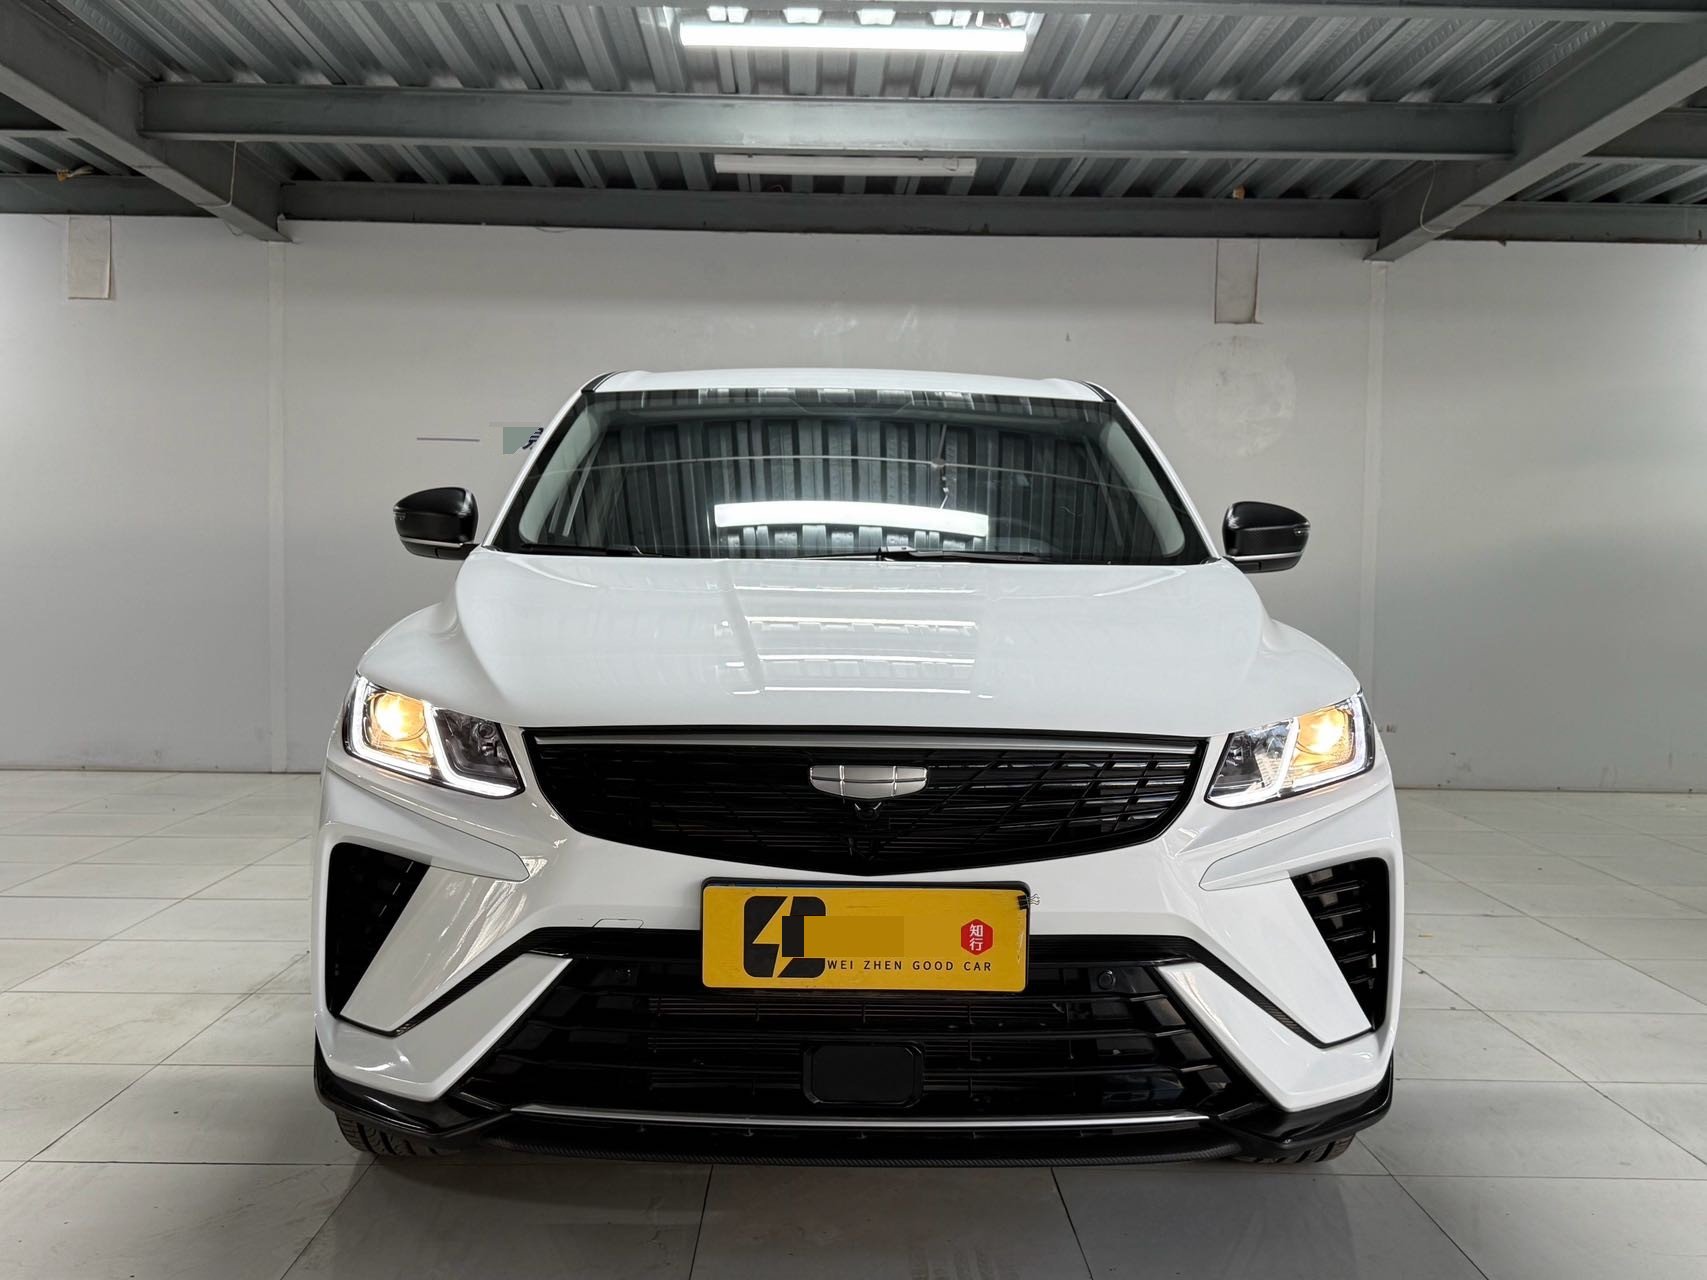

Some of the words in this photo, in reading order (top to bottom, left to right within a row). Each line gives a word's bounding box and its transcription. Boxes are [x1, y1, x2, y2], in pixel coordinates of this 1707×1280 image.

[969, 923, 984, 951] 知行
[827, 960, 854, 970] WEI
[863, 960, 902, 971] ZHEN
[912, 960, 954, 971] GOOD
[963, 961, 991, 972] CAR
